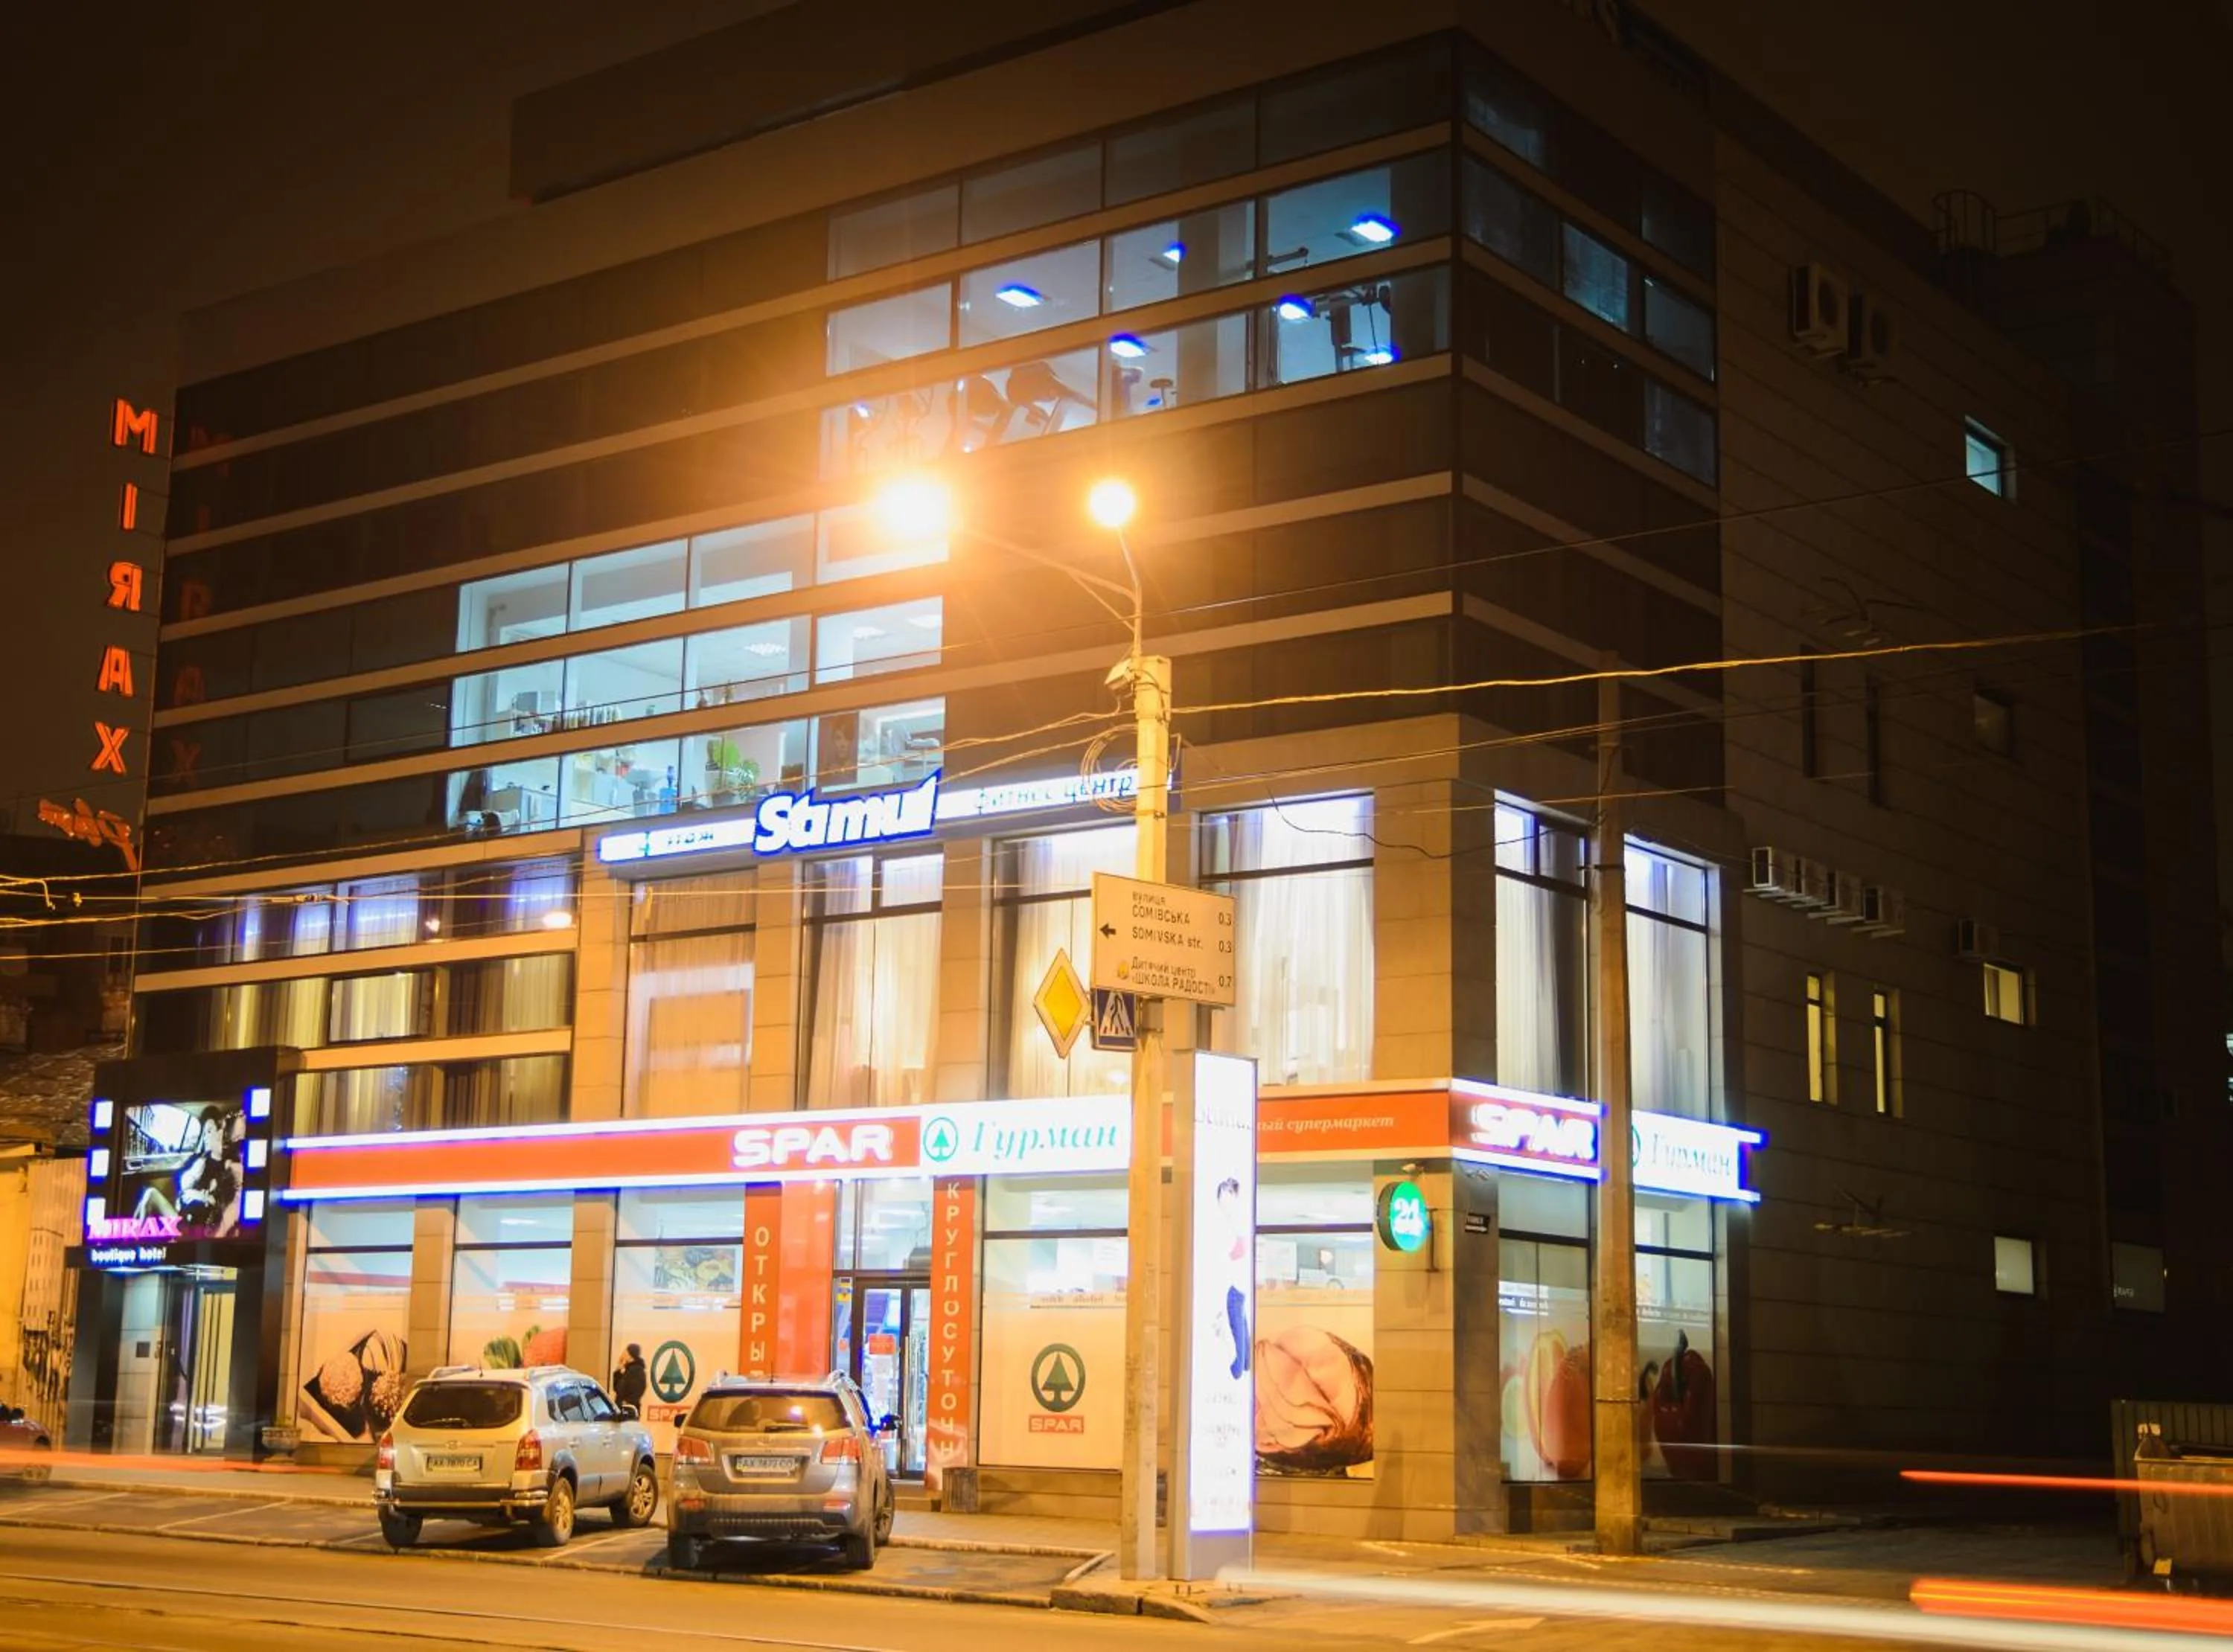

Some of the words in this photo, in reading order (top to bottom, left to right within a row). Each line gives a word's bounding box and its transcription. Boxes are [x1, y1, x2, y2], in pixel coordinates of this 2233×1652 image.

[1132, 903, 1191, 924] СОМІВСЬКА
[1218, 912, 1233, 926] 0.3
[1131, 926, 1184, 947] SOMIVSKA
[1186, 936, 1204, 950] str.
[1218, 941, 1233, 954] 0.3
[1218, 975, 1233, 988] 0.7
[1287, 1116, 1395, 1135] супермаркет
[1471, 1103, 1595, 1160] SPAR
[732, 1123, 892, 1168] SPAR
[974, 1121, 1116, 1159] Гурман
[1393, 1197, 1420, 1221] 24
[88, 1216, 182, 1240] MIRAX
[749, 1226, 770, 1377] ОТКРЫ
[1030, 1417, 1082, 1432] SPAR
